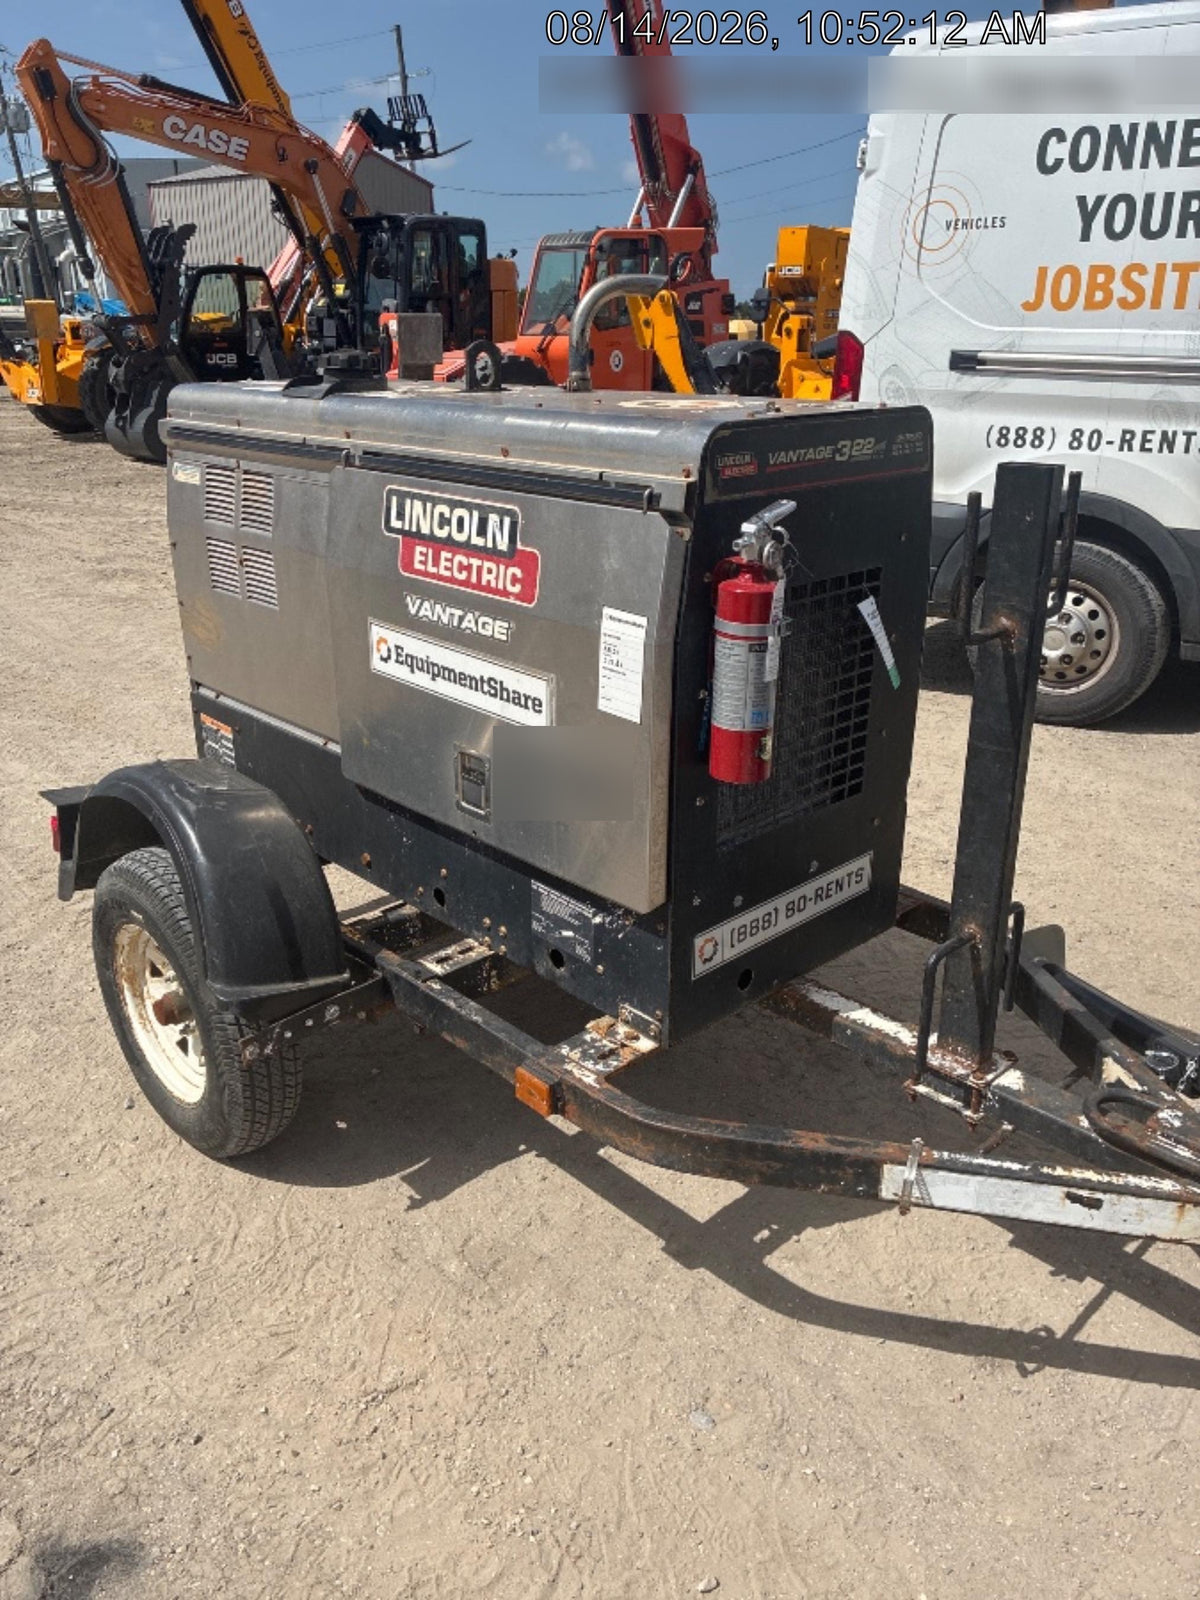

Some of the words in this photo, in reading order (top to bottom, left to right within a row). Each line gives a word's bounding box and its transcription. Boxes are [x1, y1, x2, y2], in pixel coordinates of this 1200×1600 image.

[162, 115, 250, 161] CASE
[945, 216, 1007, 231] VEHICLES
[1020, 262, 1200, 312] JOBSIT
[206, 353, 238, 364] JCB
[768, 446, 835, 465] VANTAGE
[834, 437, 876, 462] 322
[986, 425, 1056, 451] (888)
[1068, 428, 1200, 454] 80-RENT
[390, 495, 511, 552] LINCOLN
[413, 545, 523, 594] ELECTRIC
[404, 592, 510, 642] VANTAGE
[393, 644, 543, 714] EquipmentShare
[730, 906, 779, 949] (888)
[784, 866, 865, 919] 80-RENTS
